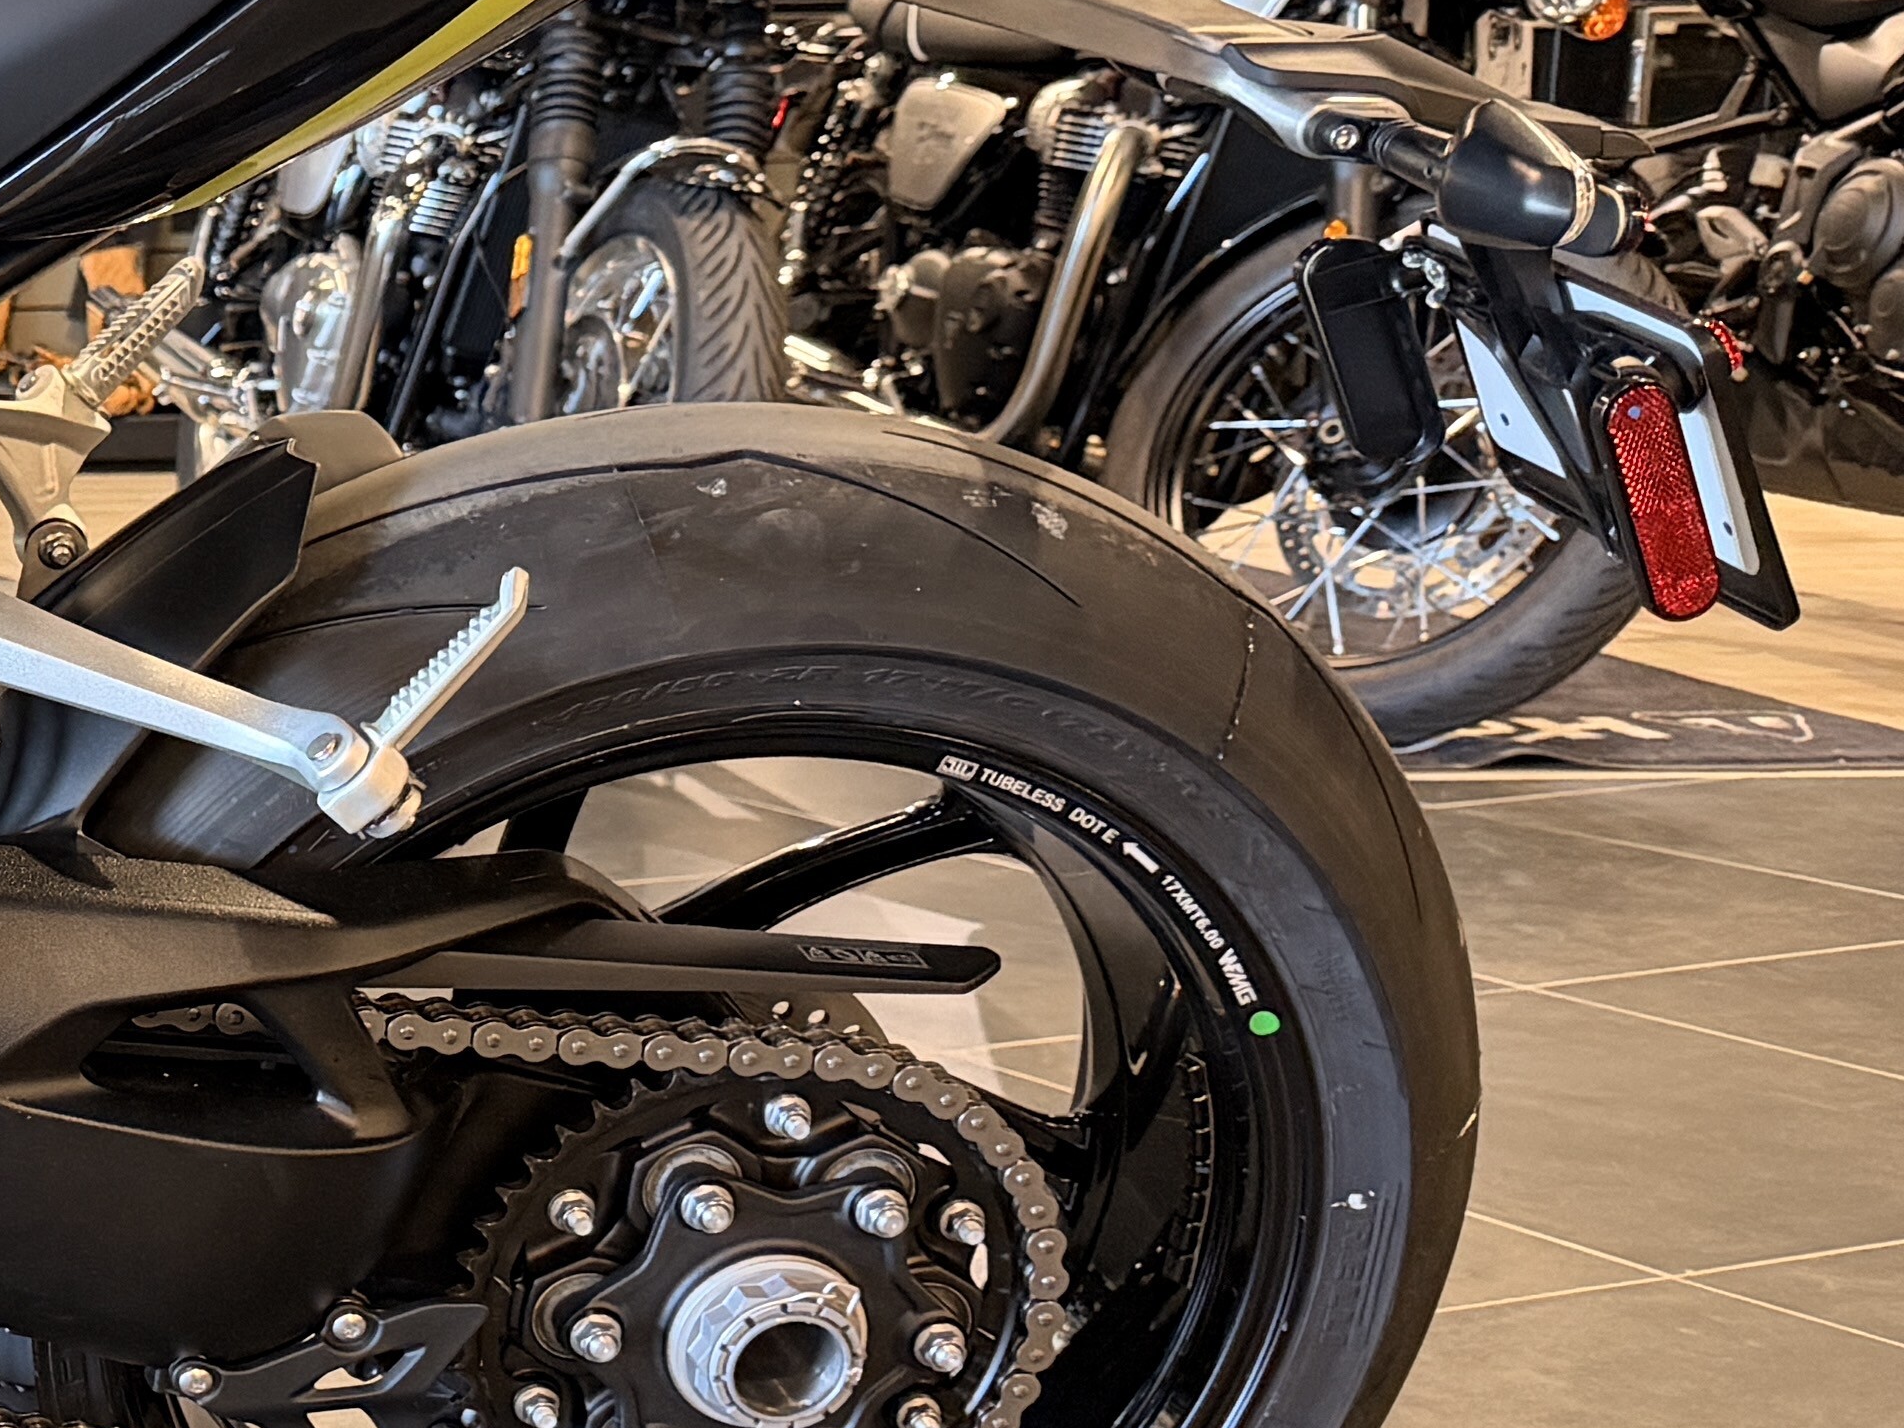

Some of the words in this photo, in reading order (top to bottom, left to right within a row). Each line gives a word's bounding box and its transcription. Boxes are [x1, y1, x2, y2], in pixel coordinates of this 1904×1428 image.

[980, 768, 1066, 812] TUBELESS
[1068, 807, 1105, 835] DOT
[1102, 828, 1120, 844] E
[1161, 875, 1224, 949] 17XMT6.00
